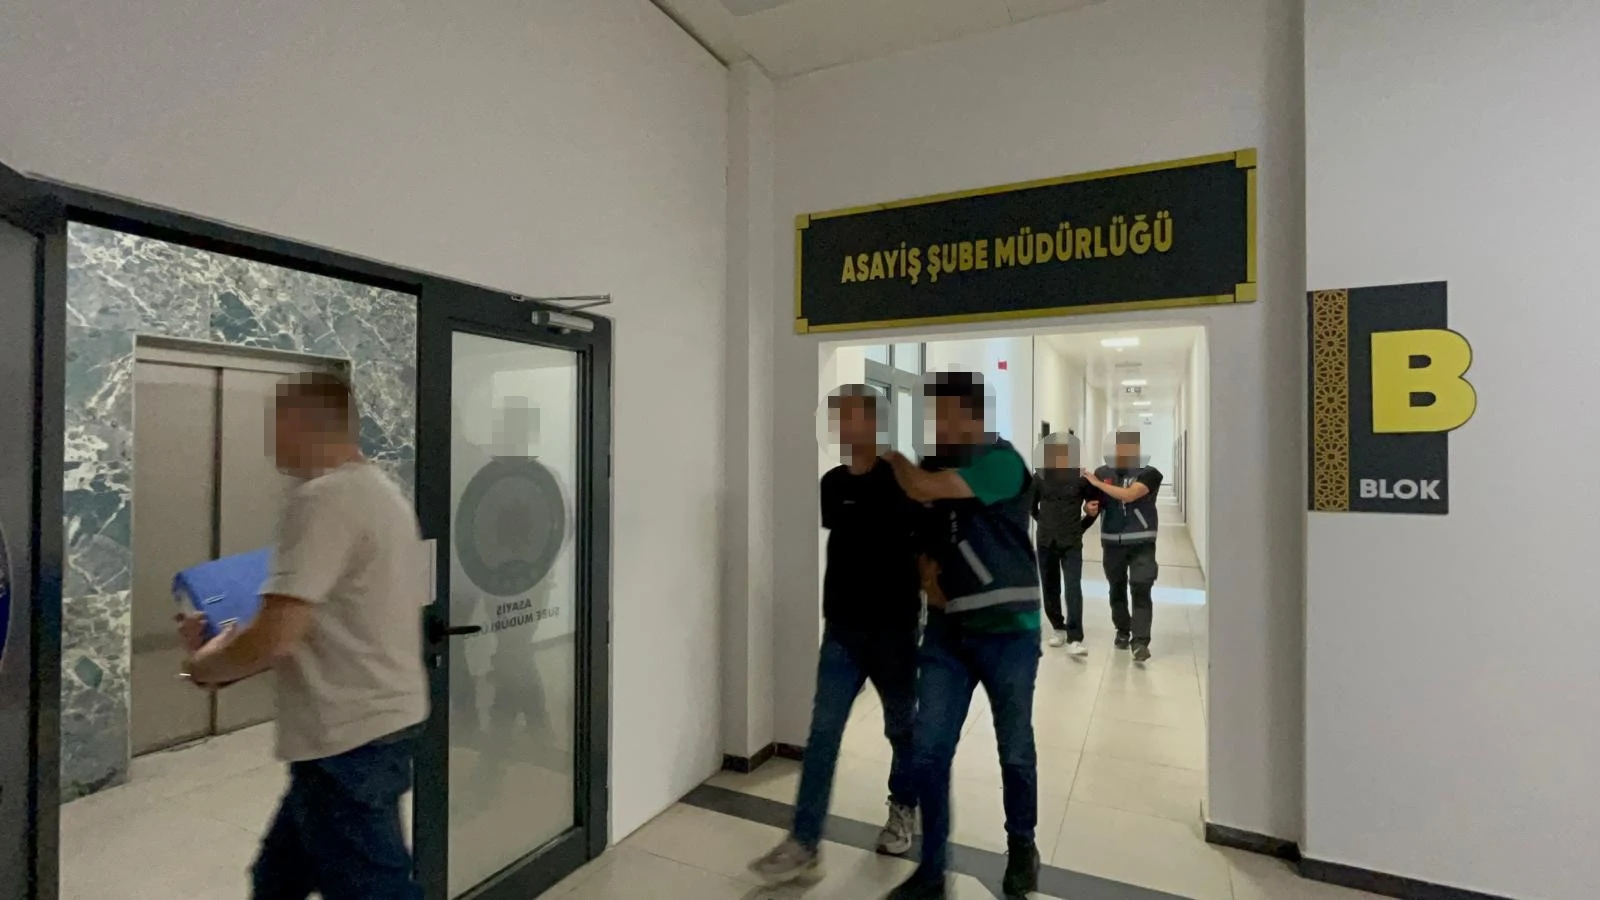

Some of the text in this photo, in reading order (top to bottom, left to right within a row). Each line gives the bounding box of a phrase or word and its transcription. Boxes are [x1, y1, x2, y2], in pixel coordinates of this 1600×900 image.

[841, 210, 1173, 285] ASAYİŞ ŞUBE MÜDÜRLÜĞÜ
[1371, 328, 1477, 433] B
[1359, 478, 1441, 500] BLOK
